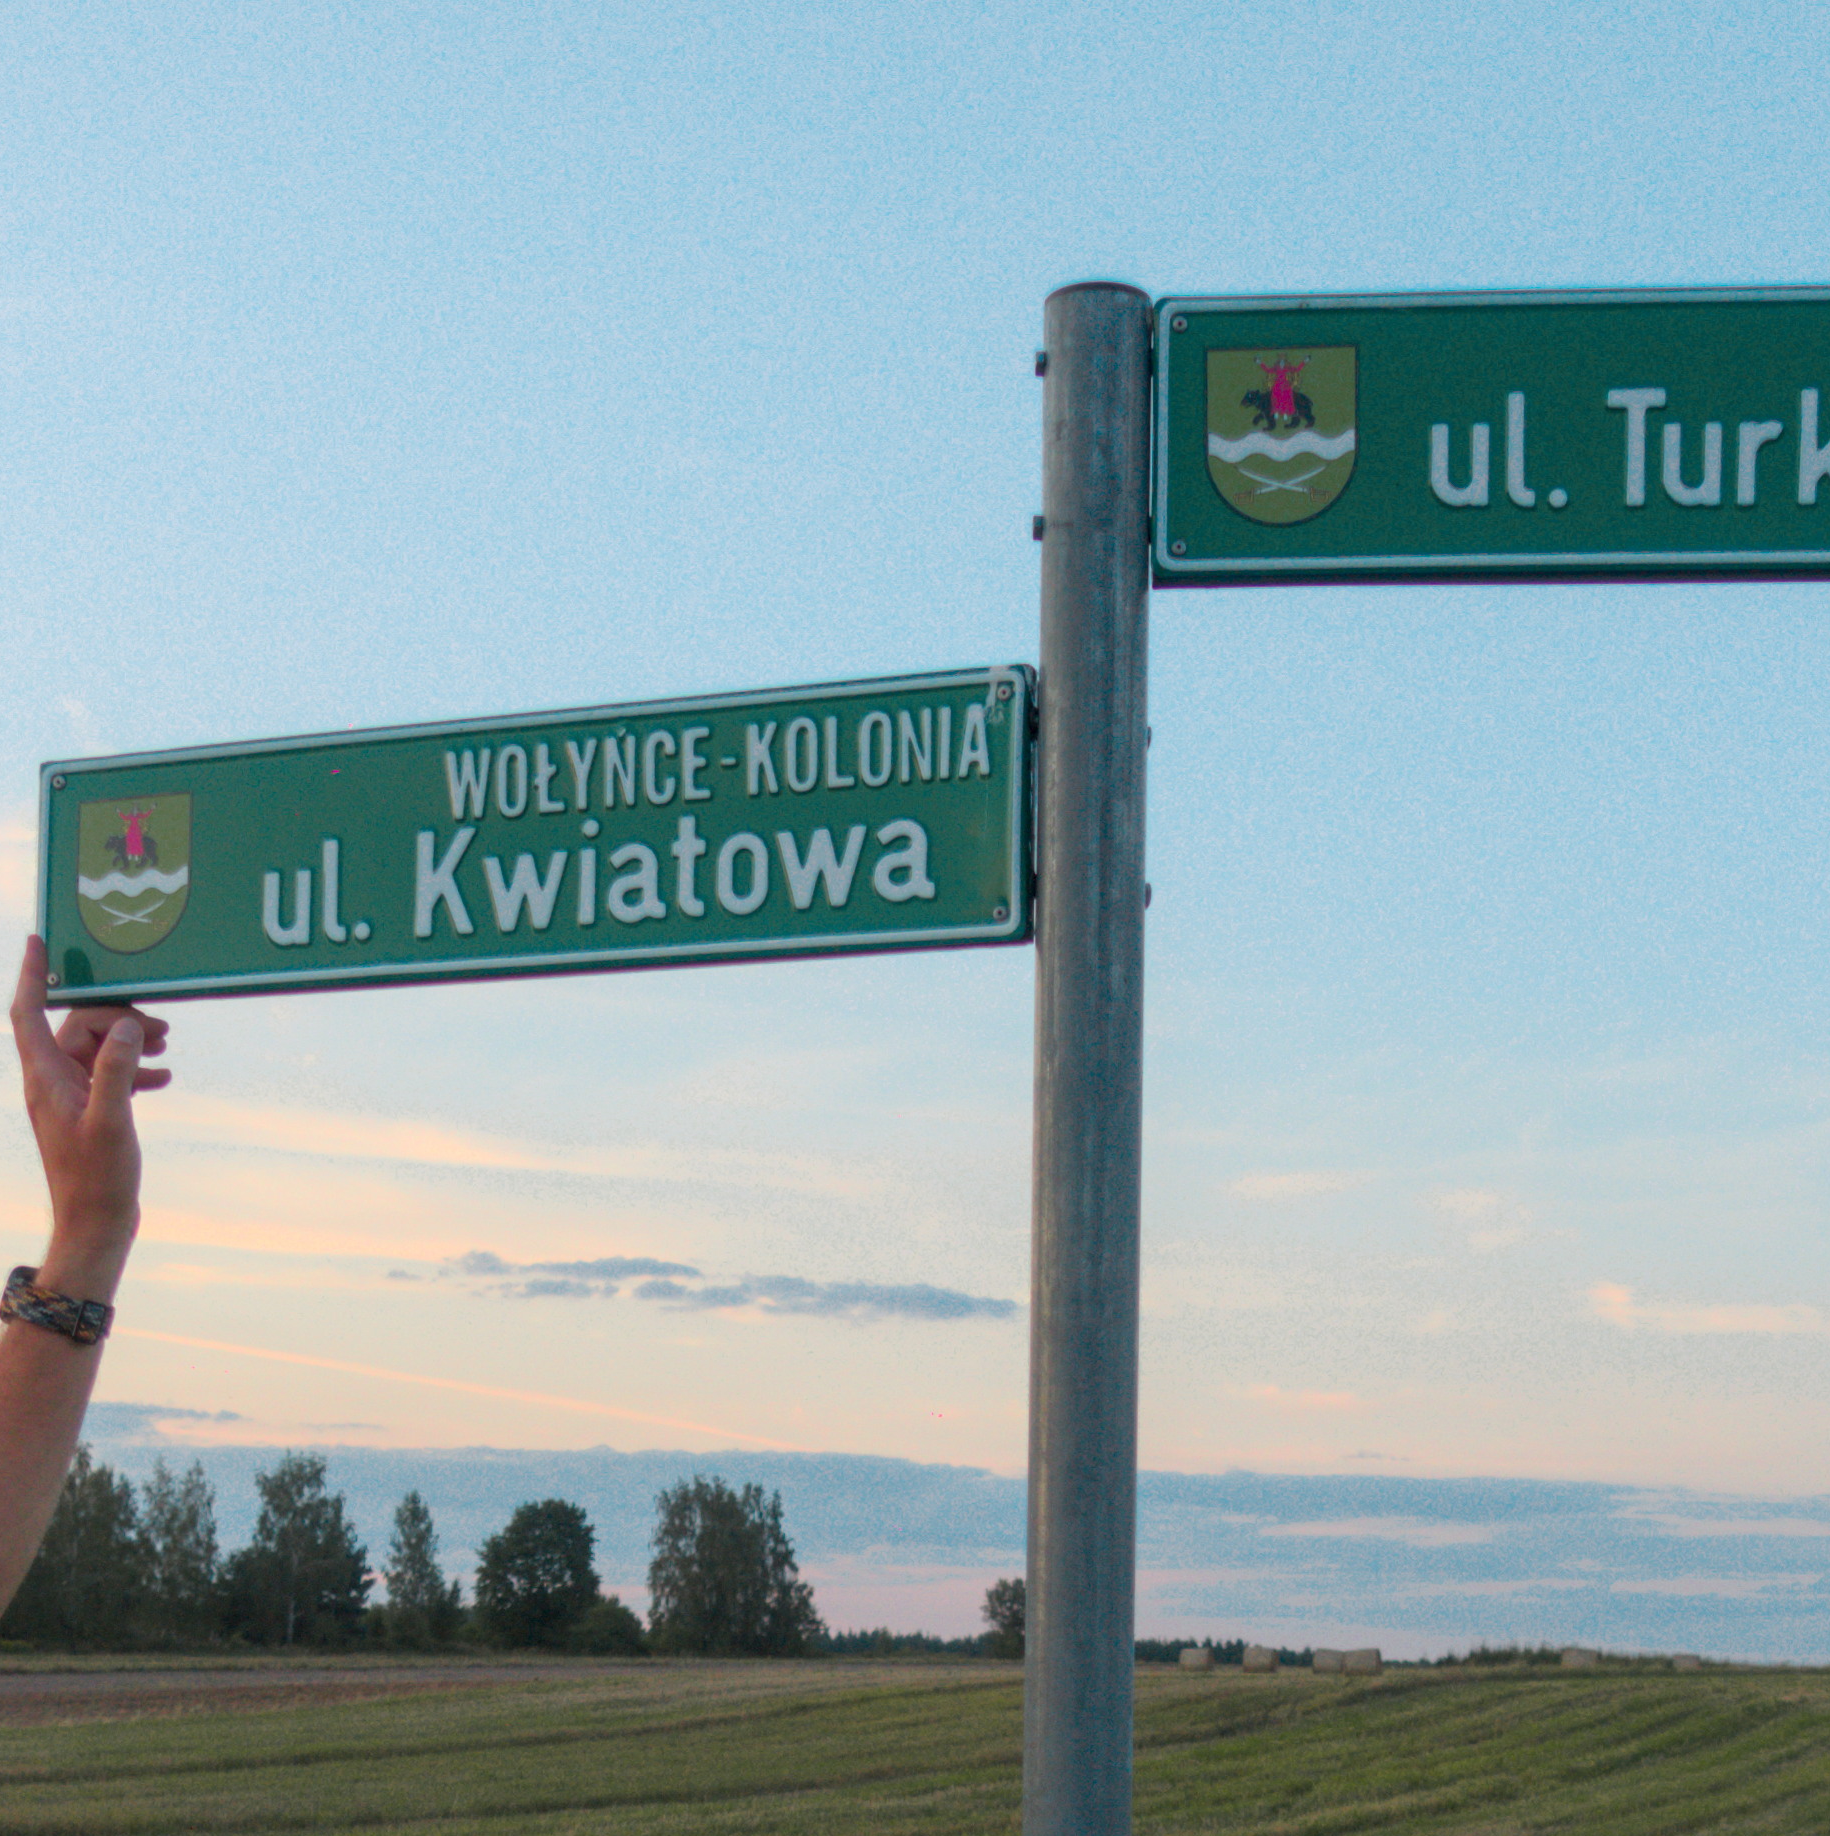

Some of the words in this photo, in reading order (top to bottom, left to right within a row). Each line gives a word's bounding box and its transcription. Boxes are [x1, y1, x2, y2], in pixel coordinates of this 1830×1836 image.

[1427, 390, 1568, 509] ul.
[260, 839, 372, 947] ul.
[412, 817, 936, 938] Kwiatowa
